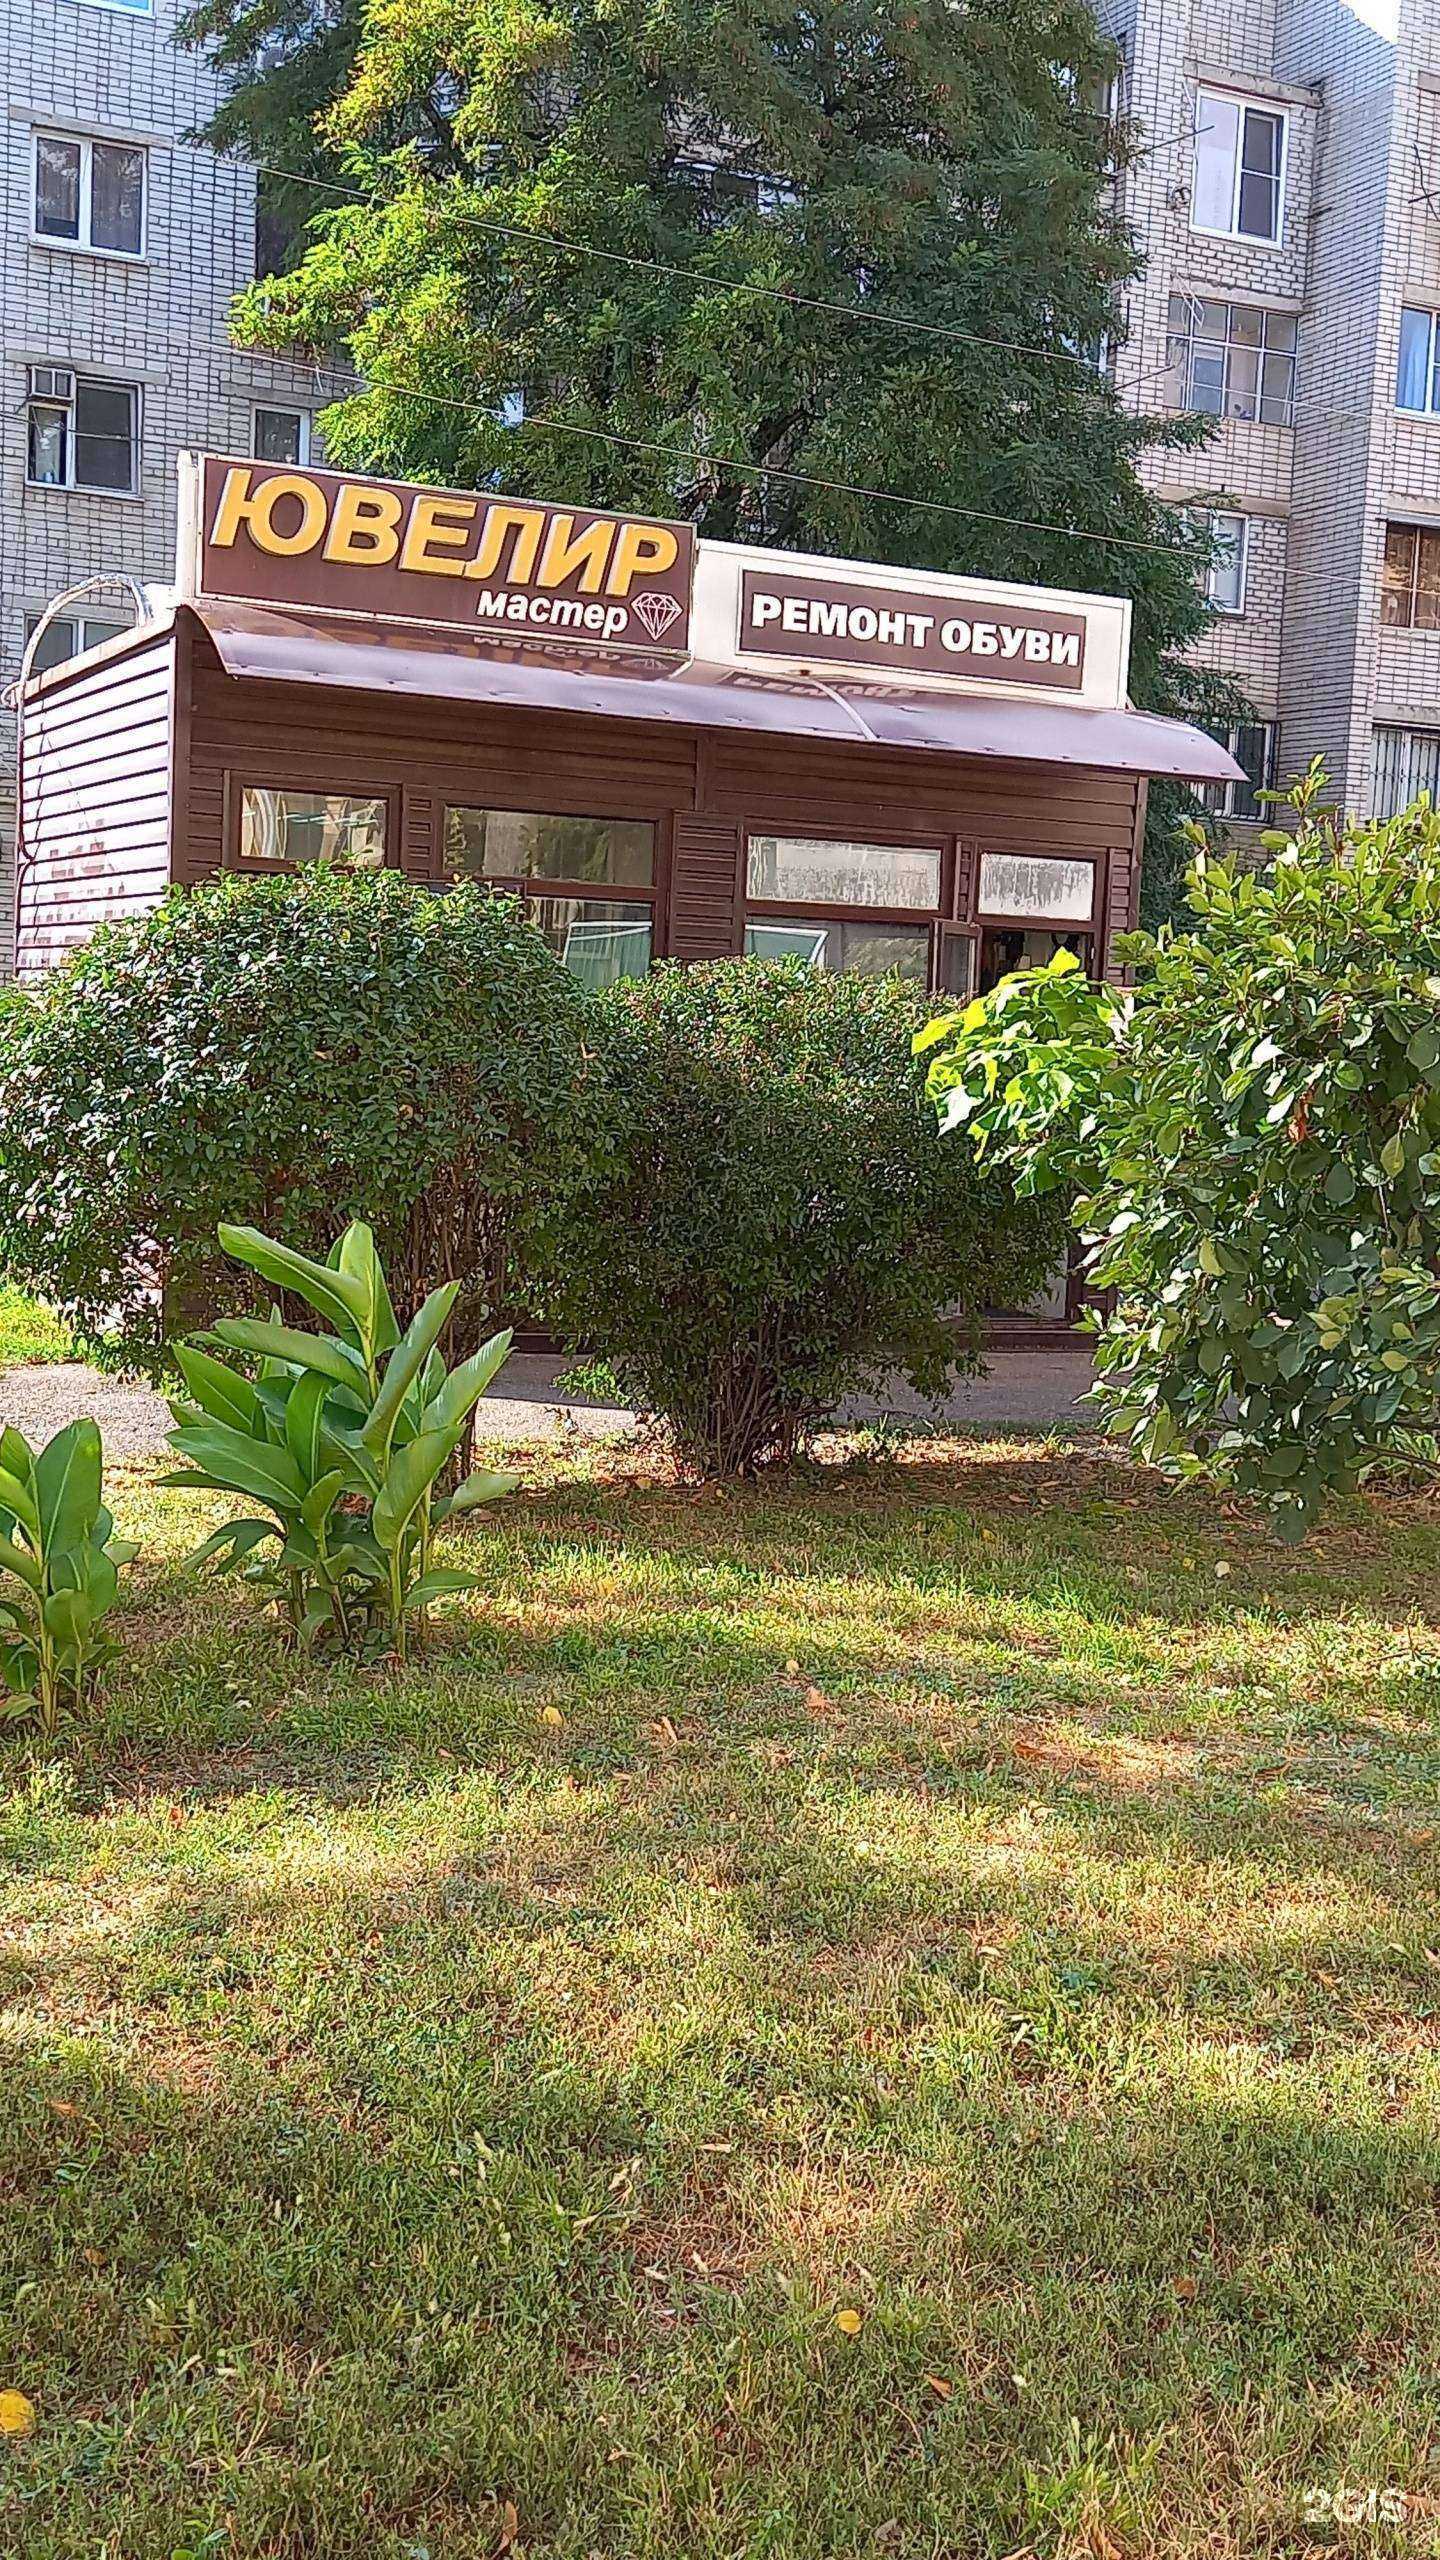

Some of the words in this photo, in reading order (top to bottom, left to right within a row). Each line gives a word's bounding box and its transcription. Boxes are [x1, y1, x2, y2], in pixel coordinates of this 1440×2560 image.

[209, 468, 680, 597] ЮВЕЛИР
[751, 593, 935, 648] РЕМОНТ
[940, 619, 1080, 667] ОБУВИ
